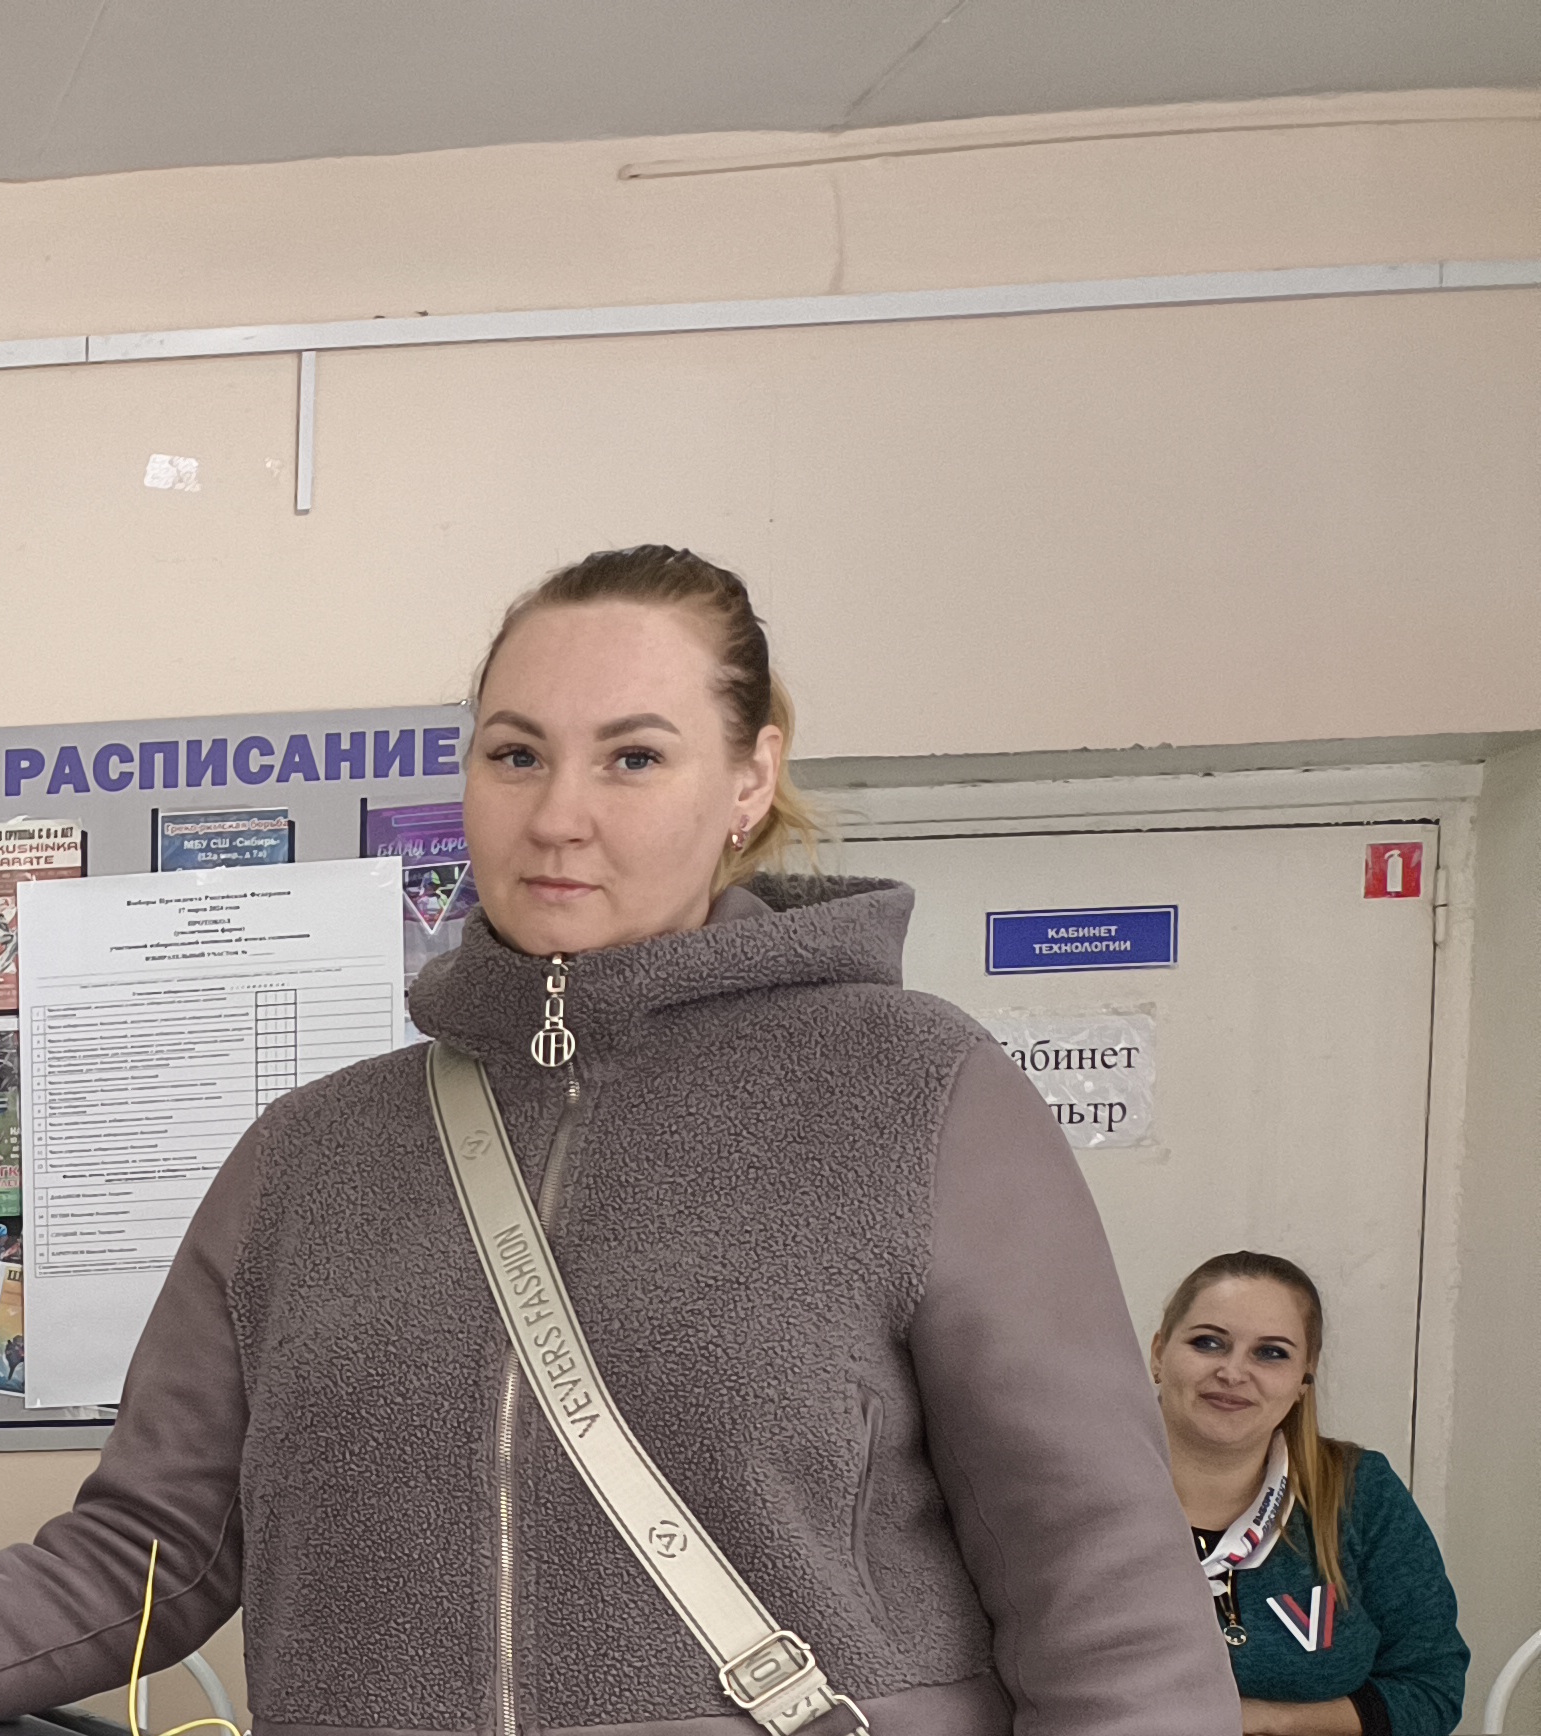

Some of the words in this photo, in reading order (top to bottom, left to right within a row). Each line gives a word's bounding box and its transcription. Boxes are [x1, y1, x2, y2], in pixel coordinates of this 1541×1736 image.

[5, 727, 460, 796] РАСПИСАНИЕ
[1033, 941, 1131, 954] ТЕХНОЛОГИИ
[1047, 925, 1118, 938] КАБИНЕТ
[1000, 1040, 1140, 1071] абинет
[493, 1223, 555, 1326] FASHION
[534, 1325, 601, 1438] VEVERS
